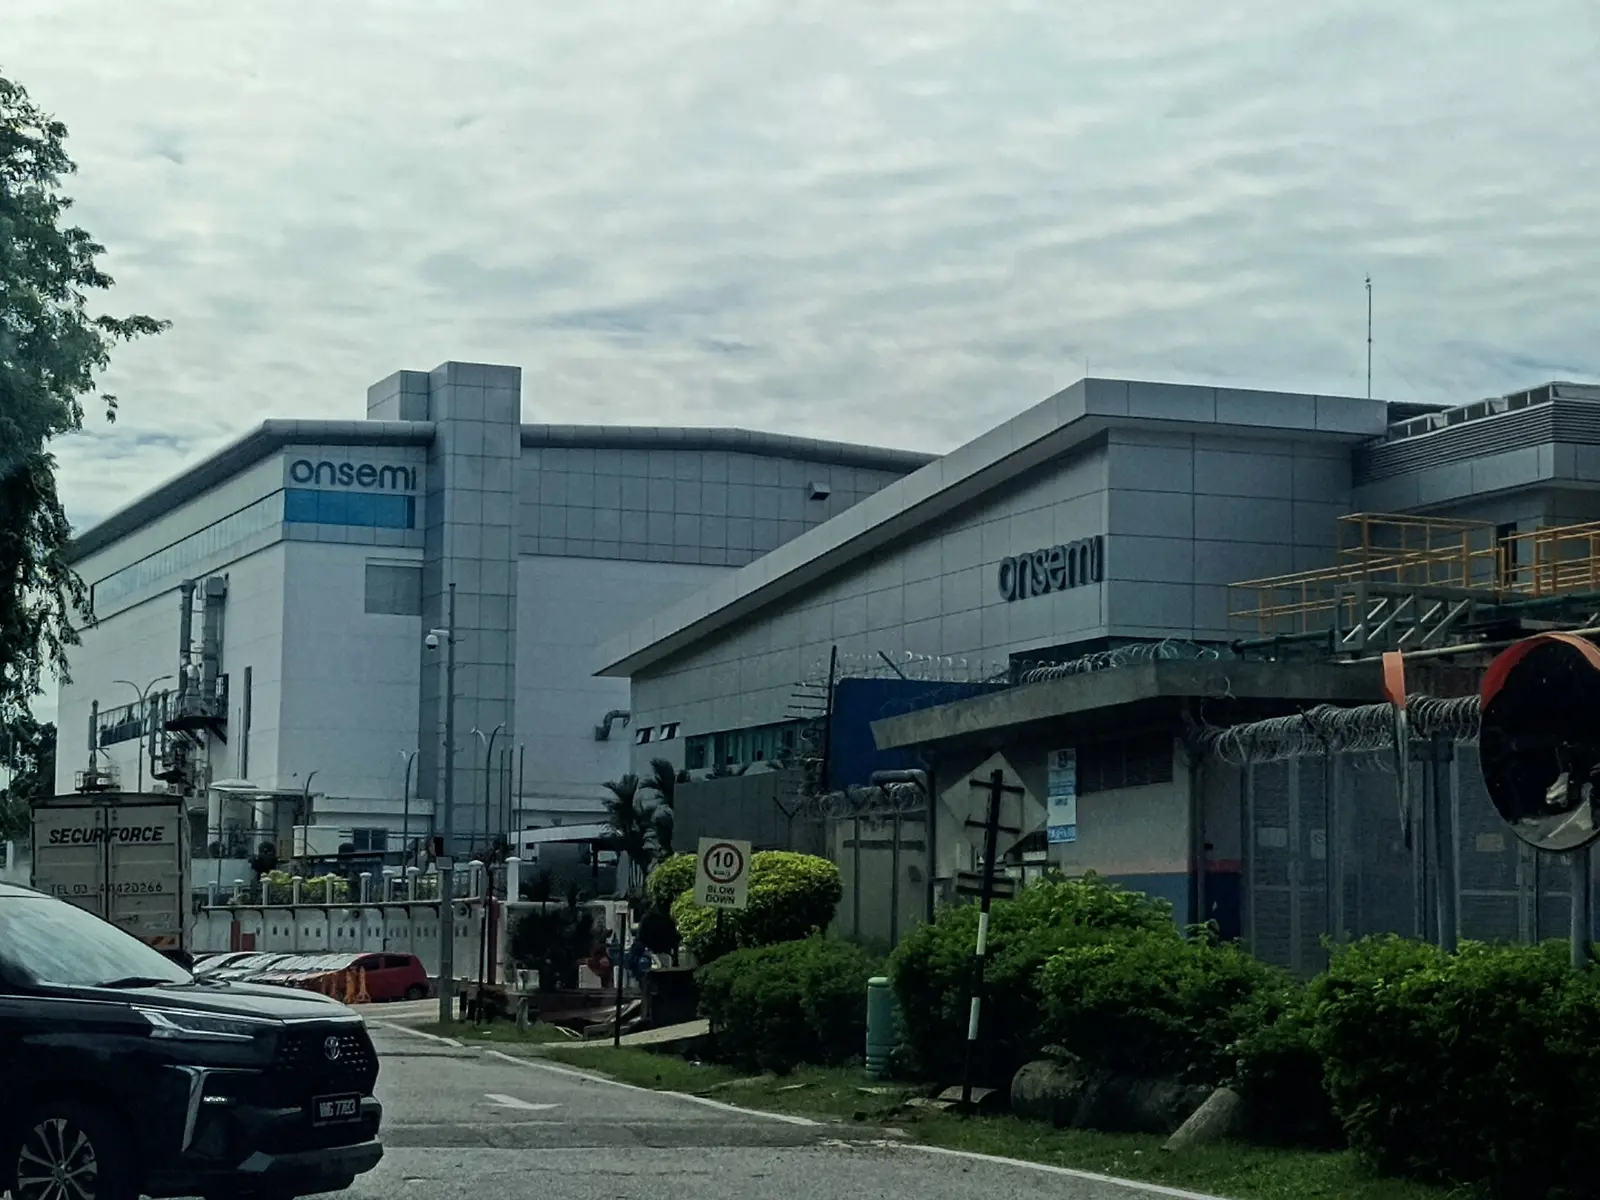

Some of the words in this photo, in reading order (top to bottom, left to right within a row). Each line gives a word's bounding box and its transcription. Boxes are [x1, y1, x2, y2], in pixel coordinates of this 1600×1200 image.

[290, 459, 417, 491] onsemi
[998, 535, 1104, 603] onsemi
[713, 851, 734, 869] 10
[707, 884, 736, 895] SLOW
[705, 894, 736, 905] DOWN
